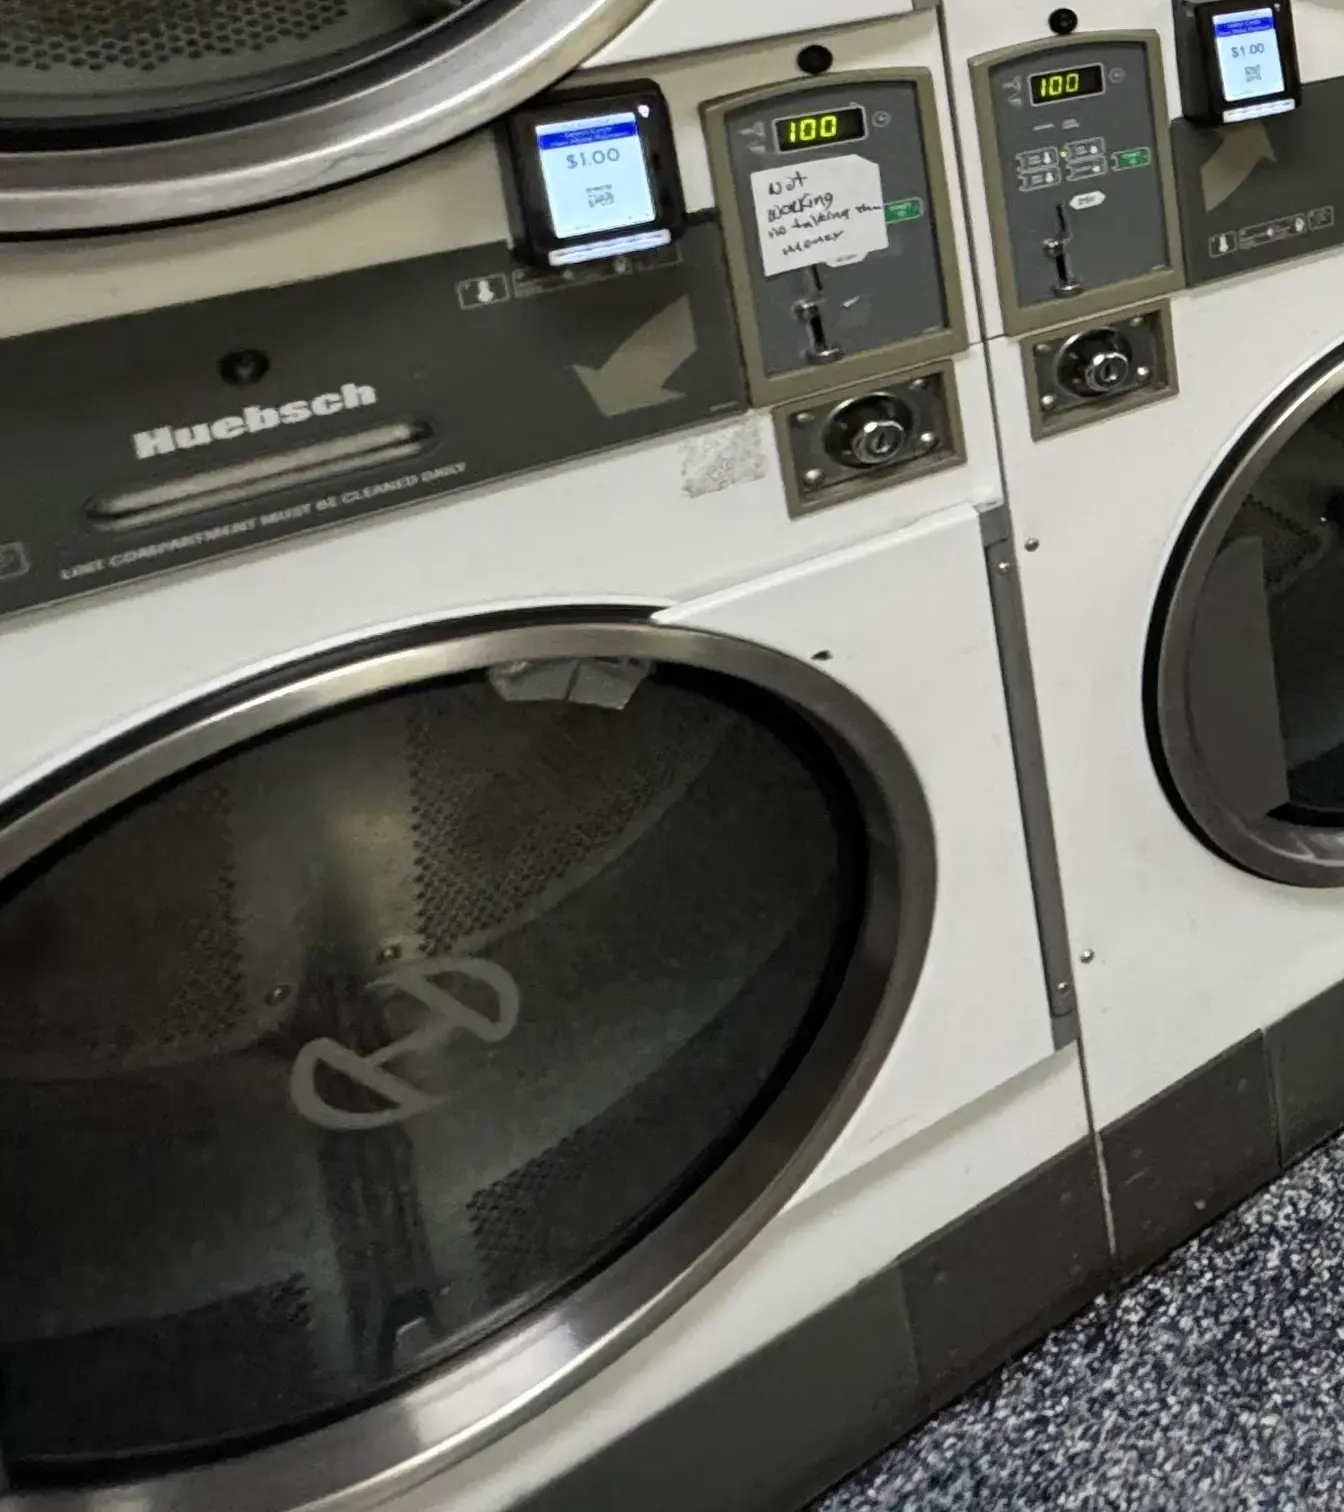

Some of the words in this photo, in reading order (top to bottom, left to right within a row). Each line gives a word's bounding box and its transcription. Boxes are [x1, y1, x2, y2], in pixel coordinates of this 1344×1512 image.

[1231, 43, 1266, 59] $1.00
[1040, 72, 1080, 98] 100
[788, 115, 838, 143] 100
[566, 147, 621, 170] $1.00
[130, 382, 379, 460] Huebsch
